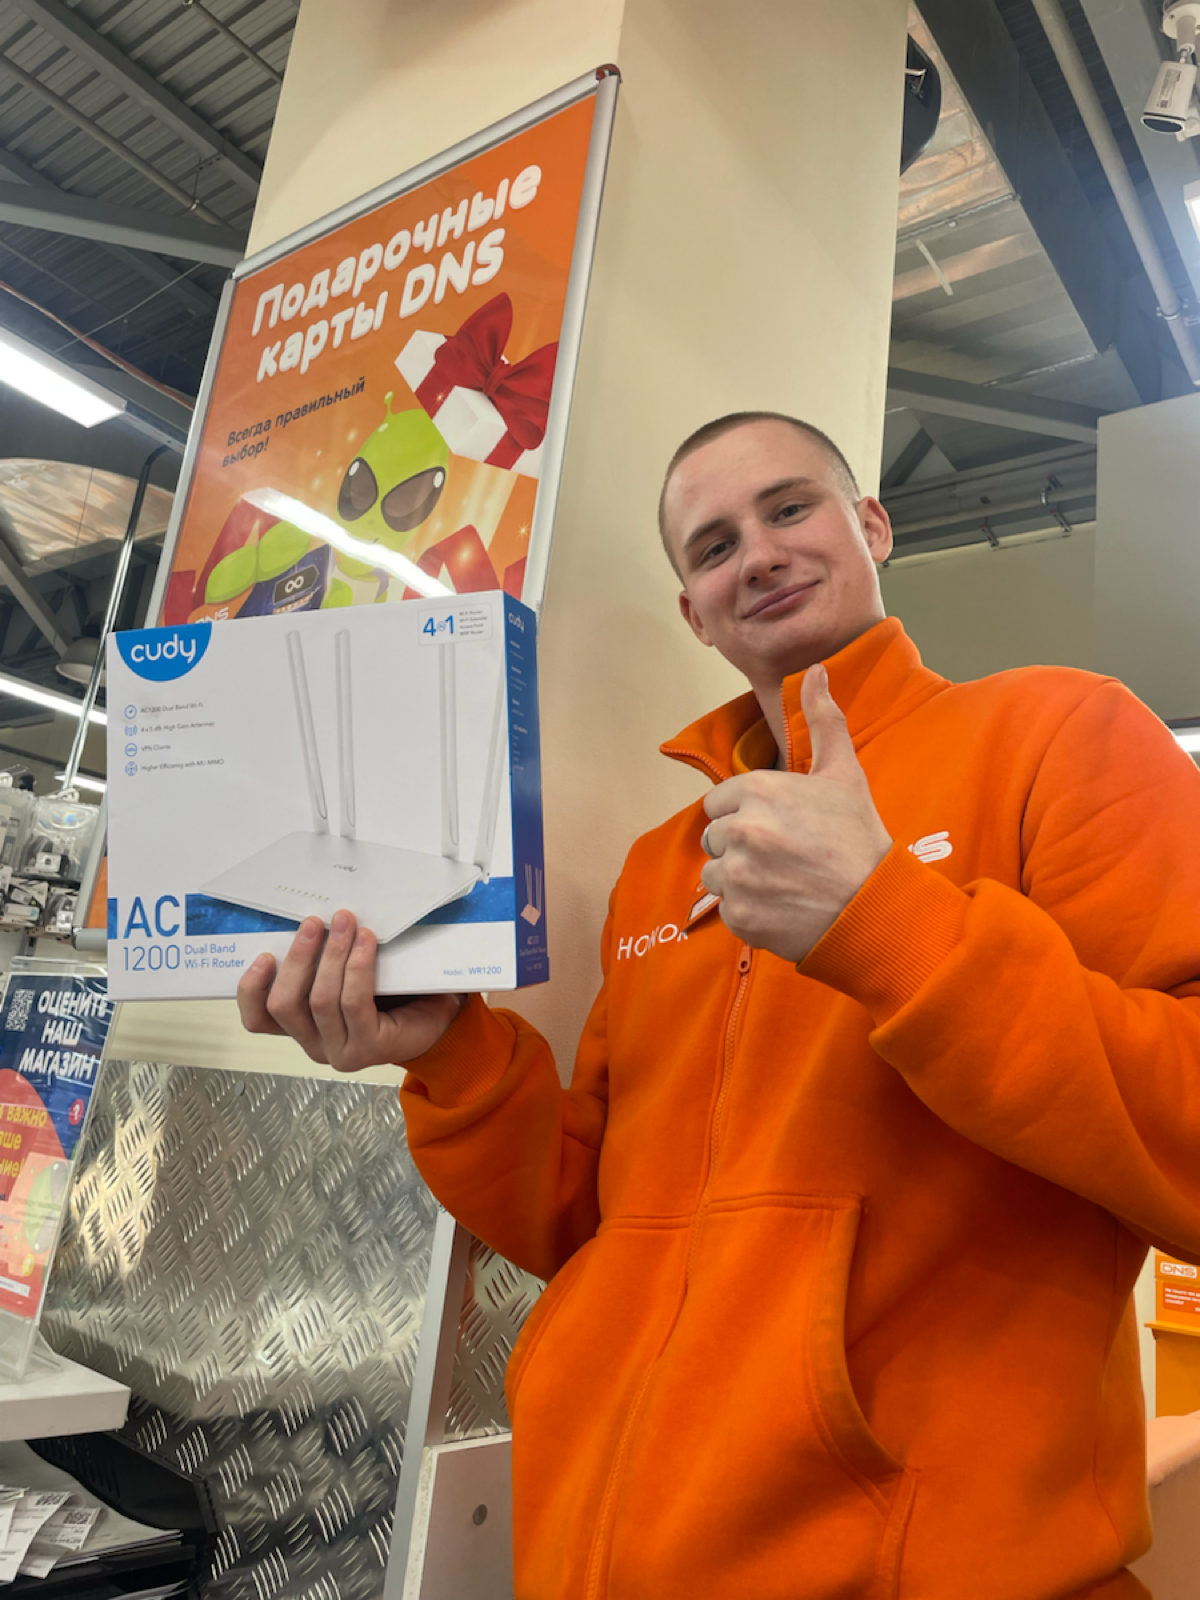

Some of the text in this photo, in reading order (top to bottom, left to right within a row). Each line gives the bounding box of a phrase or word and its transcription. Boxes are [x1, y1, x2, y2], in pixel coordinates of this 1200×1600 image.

[251, 165, 542, 336] Подарочные
[256, 228, 505, 382] карты DNS
[227, 375, 366, 447] Всегда правильный
[222, 436, 270, 468] выбор!
[423, 616, 437, 637] 4
[131, 633, 196, 663] cudy
[123, 895, 180, 939] AC
[123, 944, 180, 971] 1200
[184, 942, 236, 955] Dual Band
[184, 957, 245, 969] Wi-Fi Router
[468, 966, 502, 975] WR1200
[41, 1020, 83, 1047] НАШ
[19, 1048, 96, 1080] МАГАЗИН
[7, 1105, 48, 1128] важно
[1162, 1263, 1196, 1278] DNS
